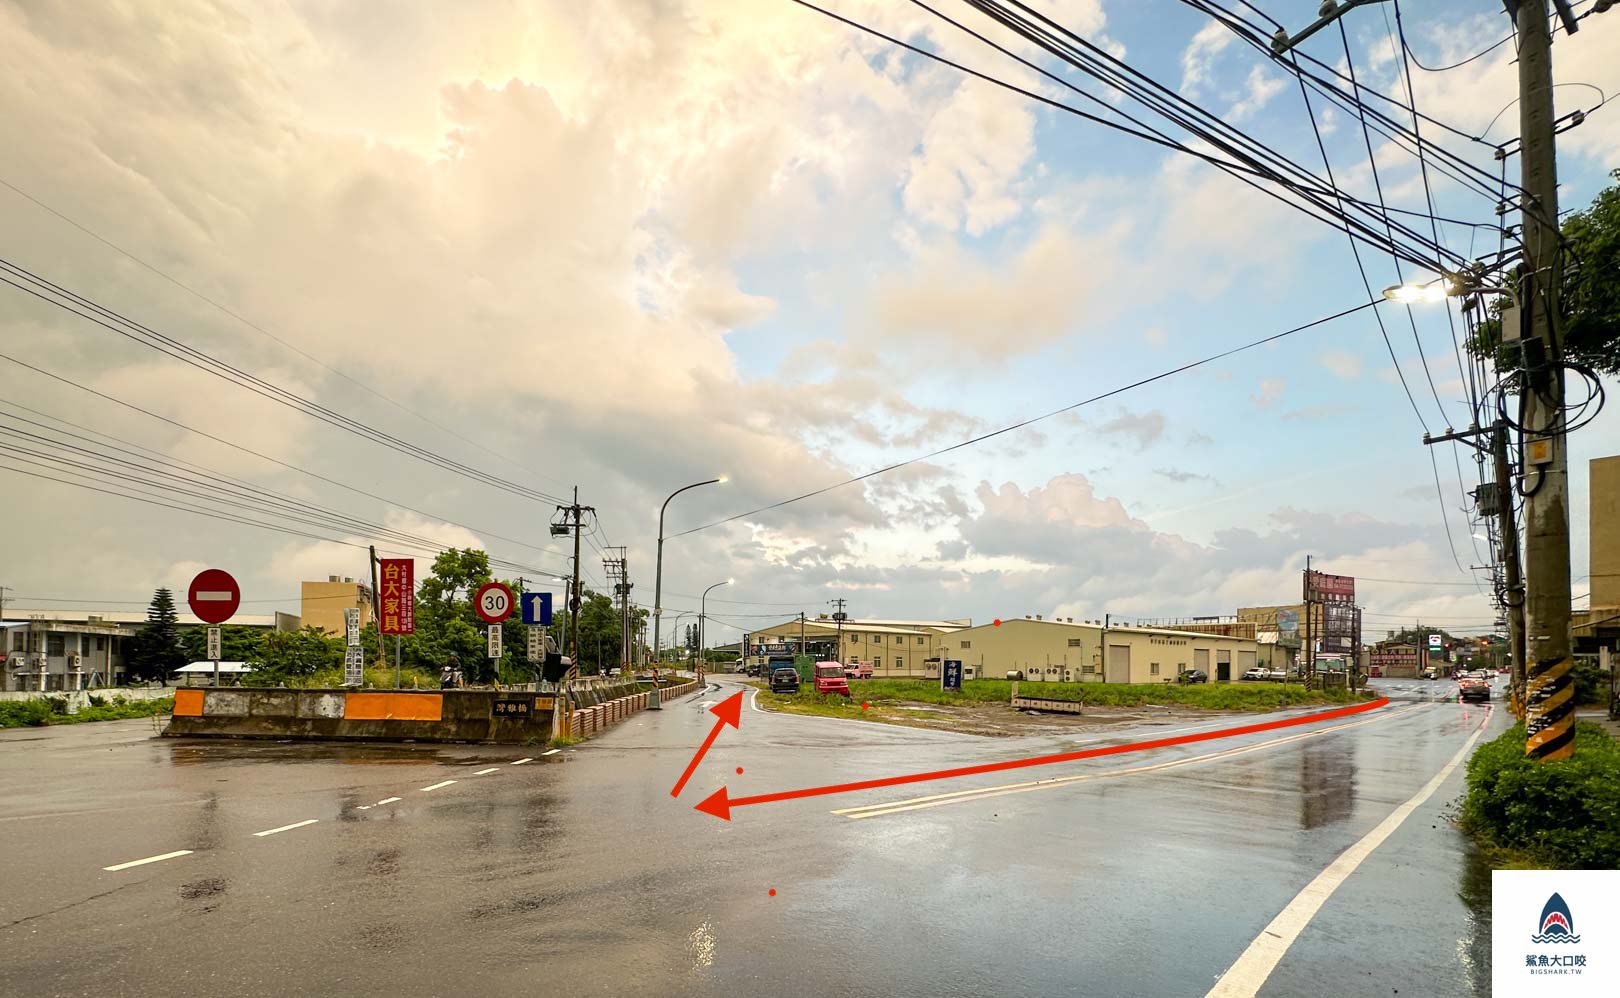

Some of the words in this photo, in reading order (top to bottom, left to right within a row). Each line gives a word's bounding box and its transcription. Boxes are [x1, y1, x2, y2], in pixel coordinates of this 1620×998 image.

[384, 563, 400, 631] 台大家具
[485, 595, 505, 610] 30
[210, 629, 218, 658] 禁止進入
[491, 626, 500, 656] 最高限速
